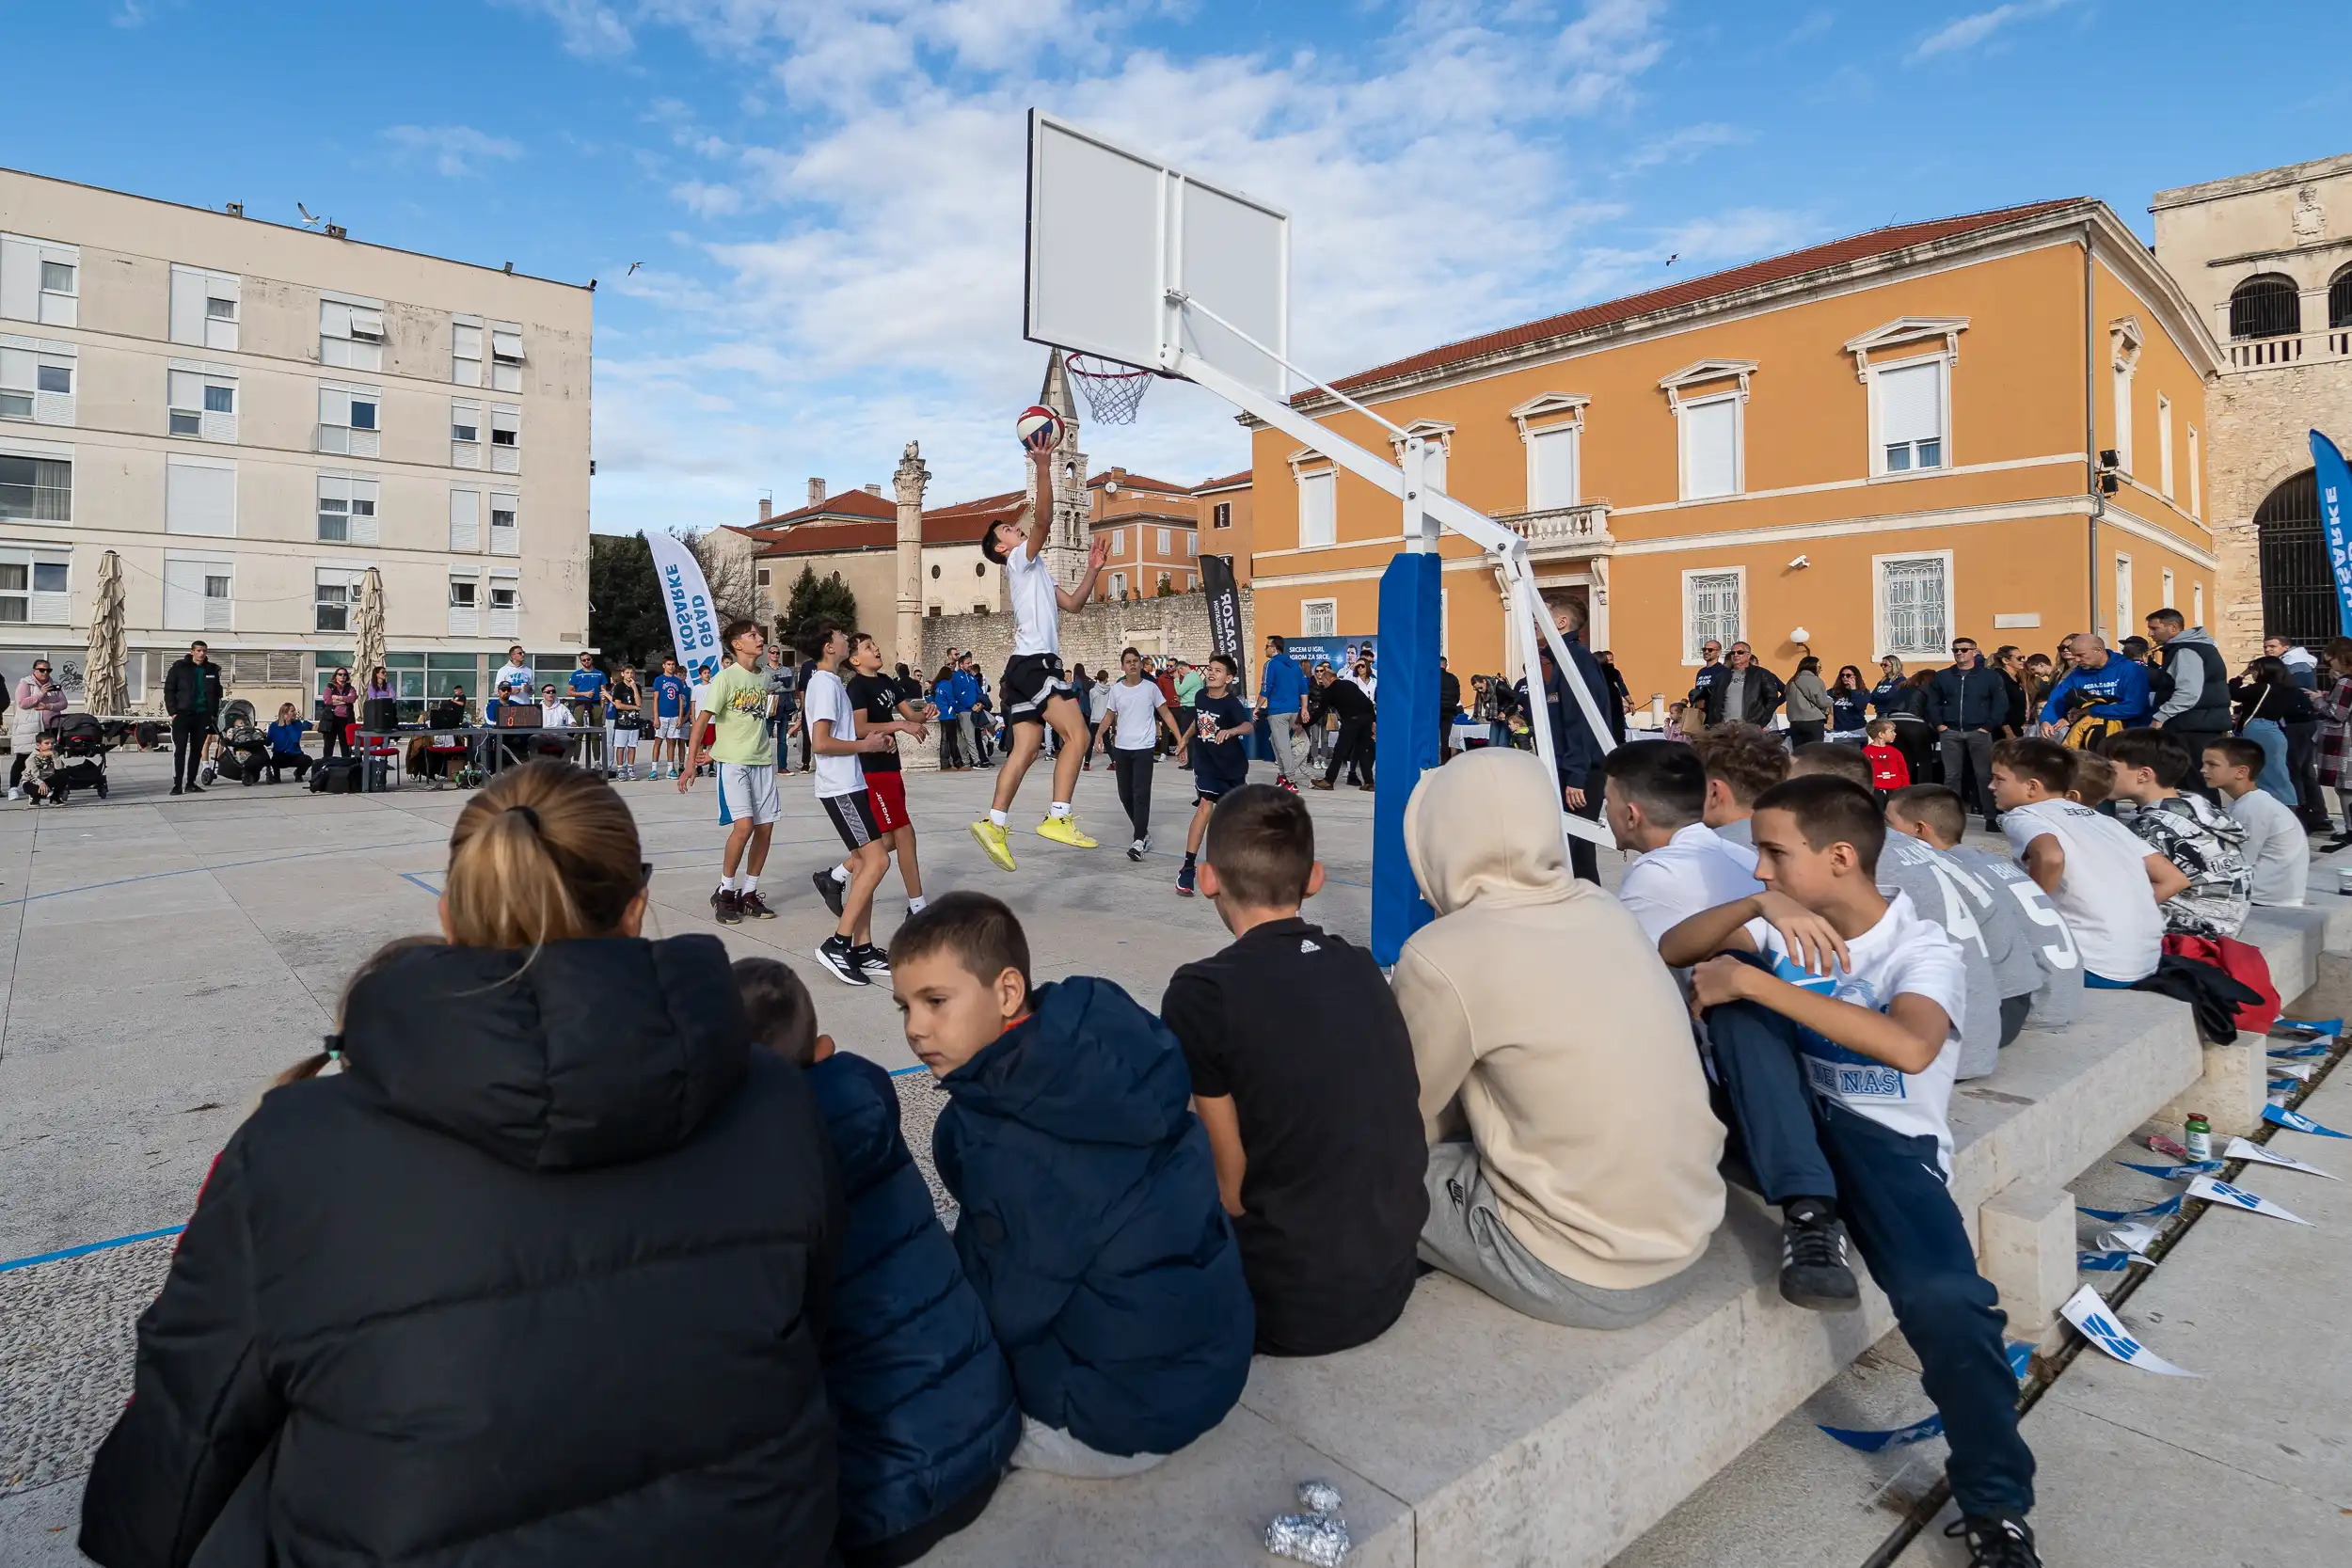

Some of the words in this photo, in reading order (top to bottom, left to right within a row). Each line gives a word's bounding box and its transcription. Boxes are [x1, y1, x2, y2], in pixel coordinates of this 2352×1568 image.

[667, 688, 675, 700] 3
[507, 716, 514, 727] 0
[875, 791, 892, 824] JORDAN
[2008, 880, 2078, 970] 5
[1840, 1065, 1899, 1095] NAŠ
